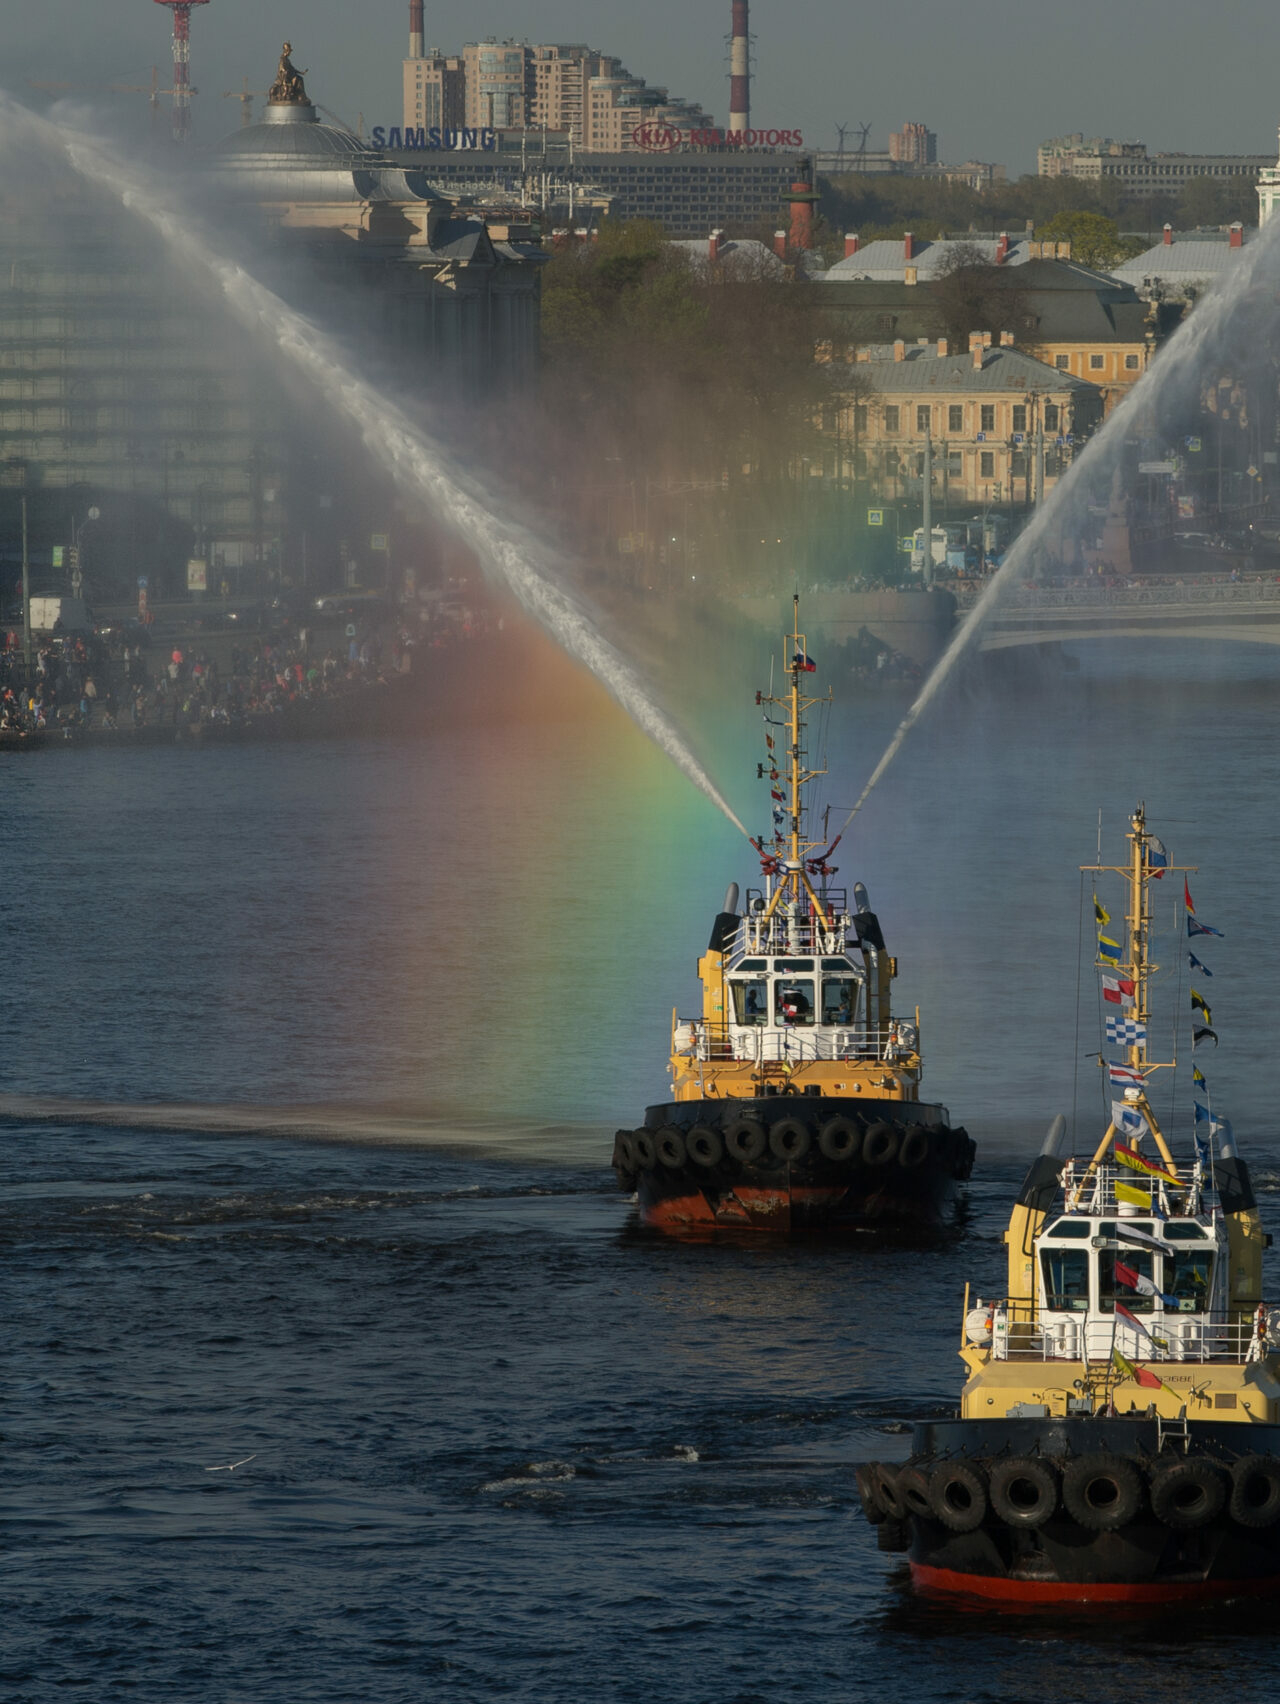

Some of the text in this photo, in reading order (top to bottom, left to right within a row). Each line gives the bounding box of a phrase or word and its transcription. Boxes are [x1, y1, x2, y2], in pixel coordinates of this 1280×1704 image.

[372, 126, 496, 150] SAMSUNG
[640, 128, 675, 146] KIA
[690, 128, 804, 147] KIA MOTORS
